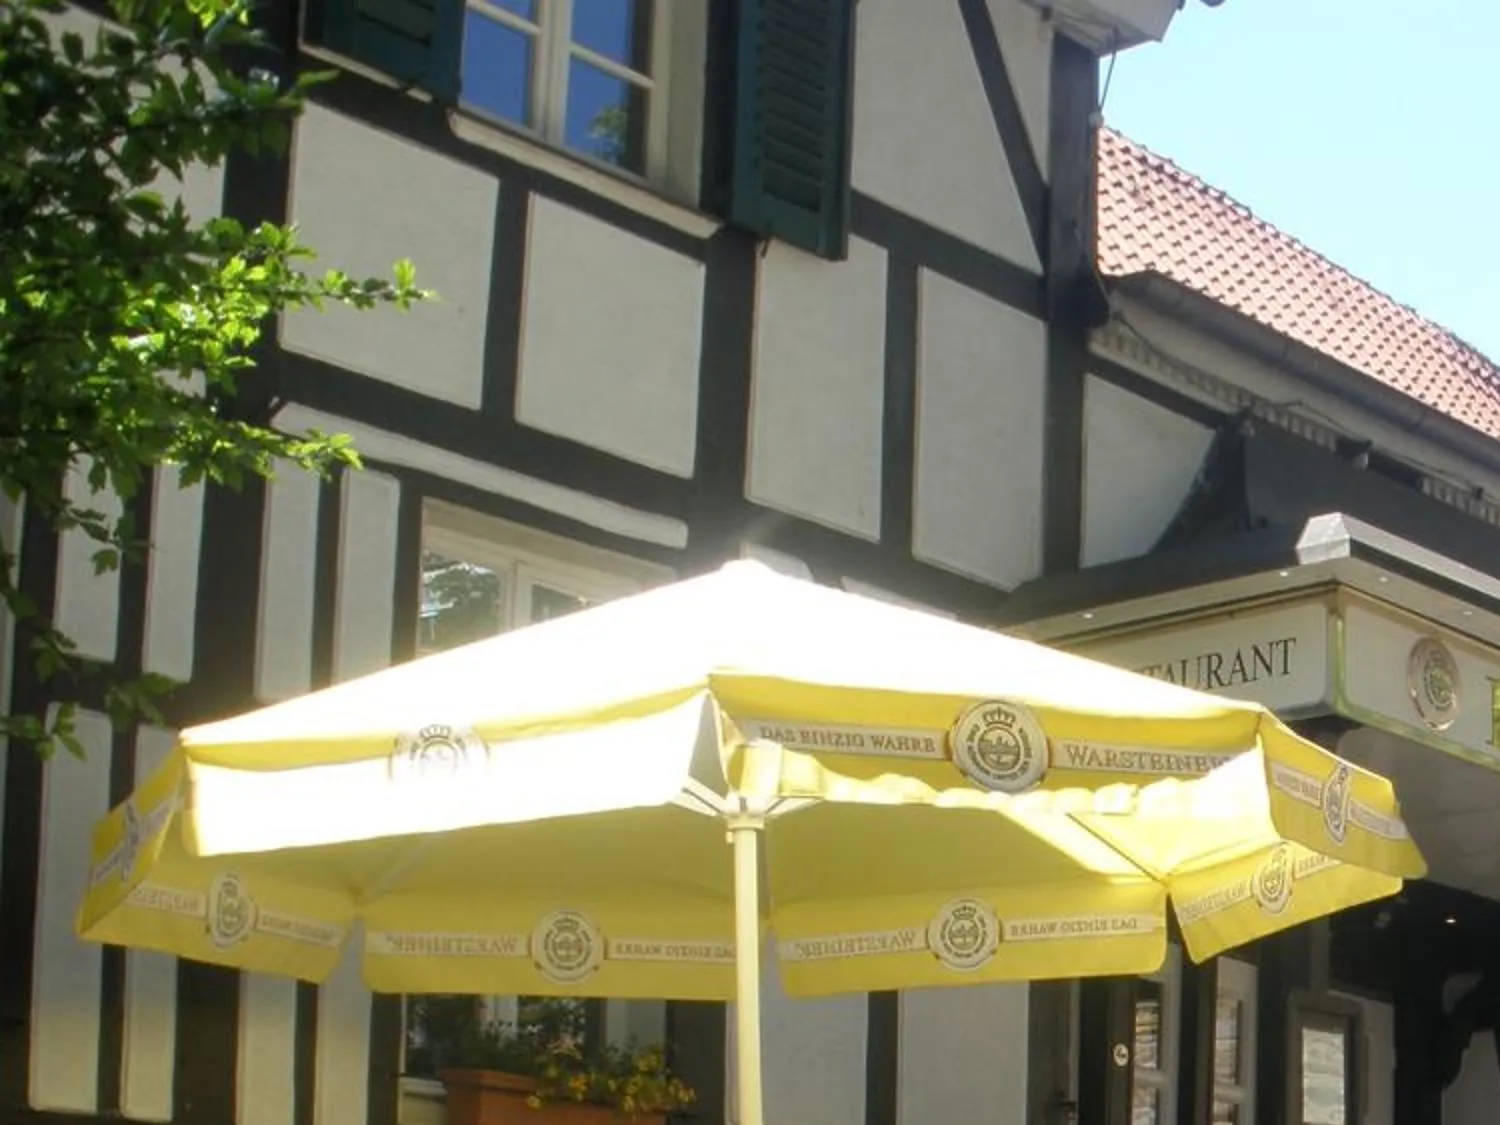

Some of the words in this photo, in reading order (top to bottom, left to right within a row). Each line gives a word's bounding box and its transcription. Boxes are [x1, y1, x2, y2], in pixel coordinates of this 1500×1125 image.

[759, 725, 796, 745] DAS
[799, 730, 865, 748] EINZIG
[870, 734, 936, 753] WAHRE
